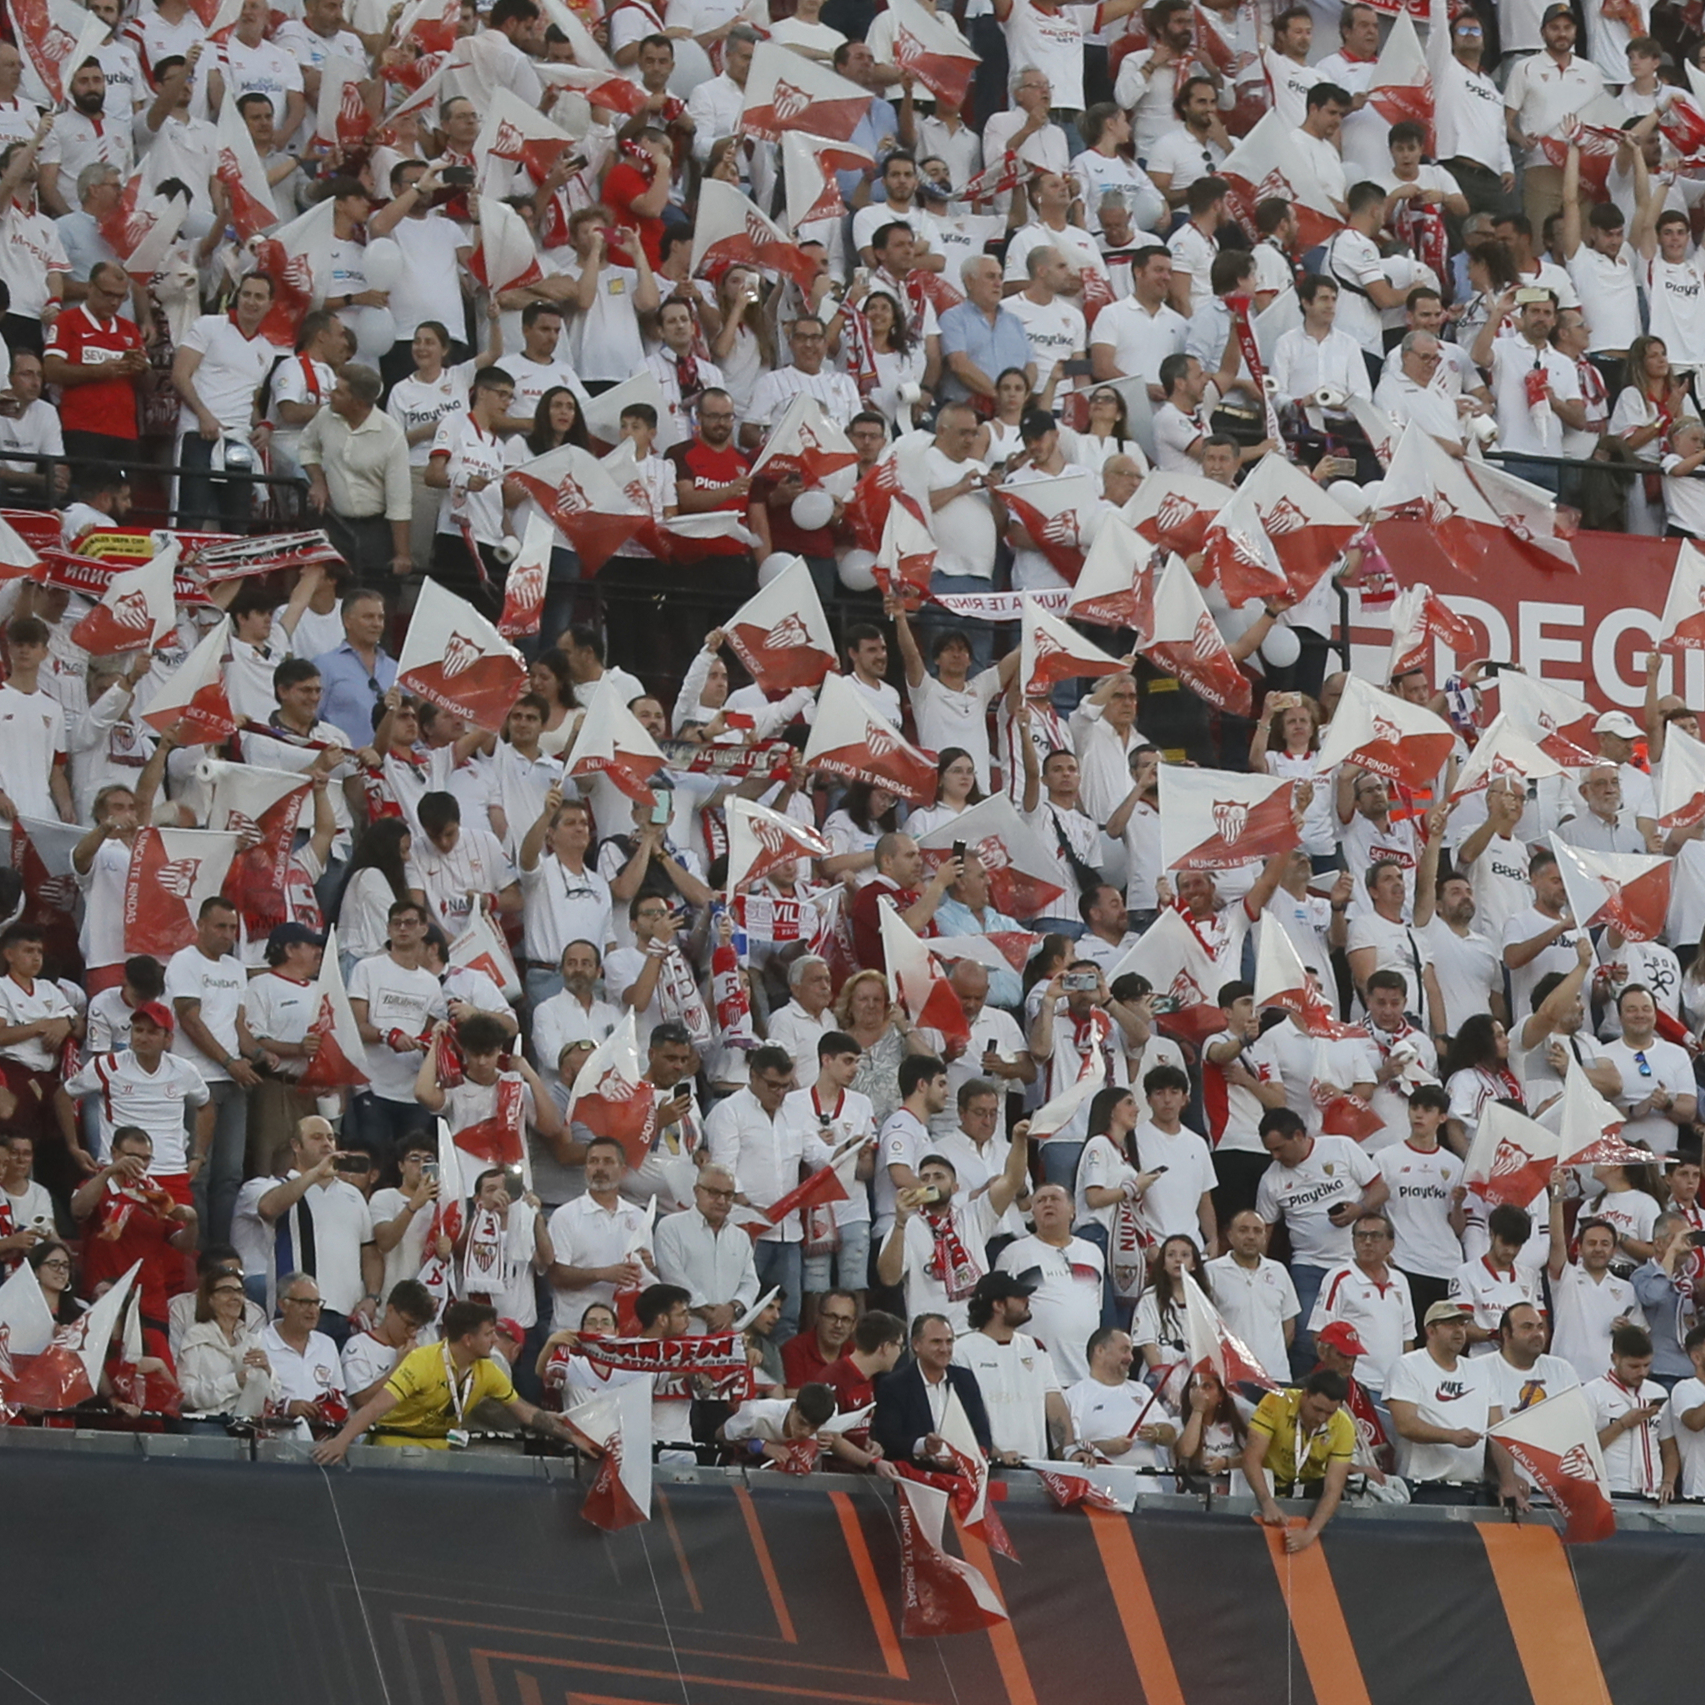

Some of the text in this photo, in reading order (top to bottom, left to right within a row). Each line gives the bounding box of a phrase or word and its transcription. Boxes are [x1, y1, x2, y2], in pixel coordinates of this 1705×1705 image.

[818, 758, 856, 778] NUNCA
[1288, 1180, 1344, 1208] Playtika
[1509, 1443, 1537, 1475] NUNCA
[1545, 1482, 1572, 1518] RINDAS
